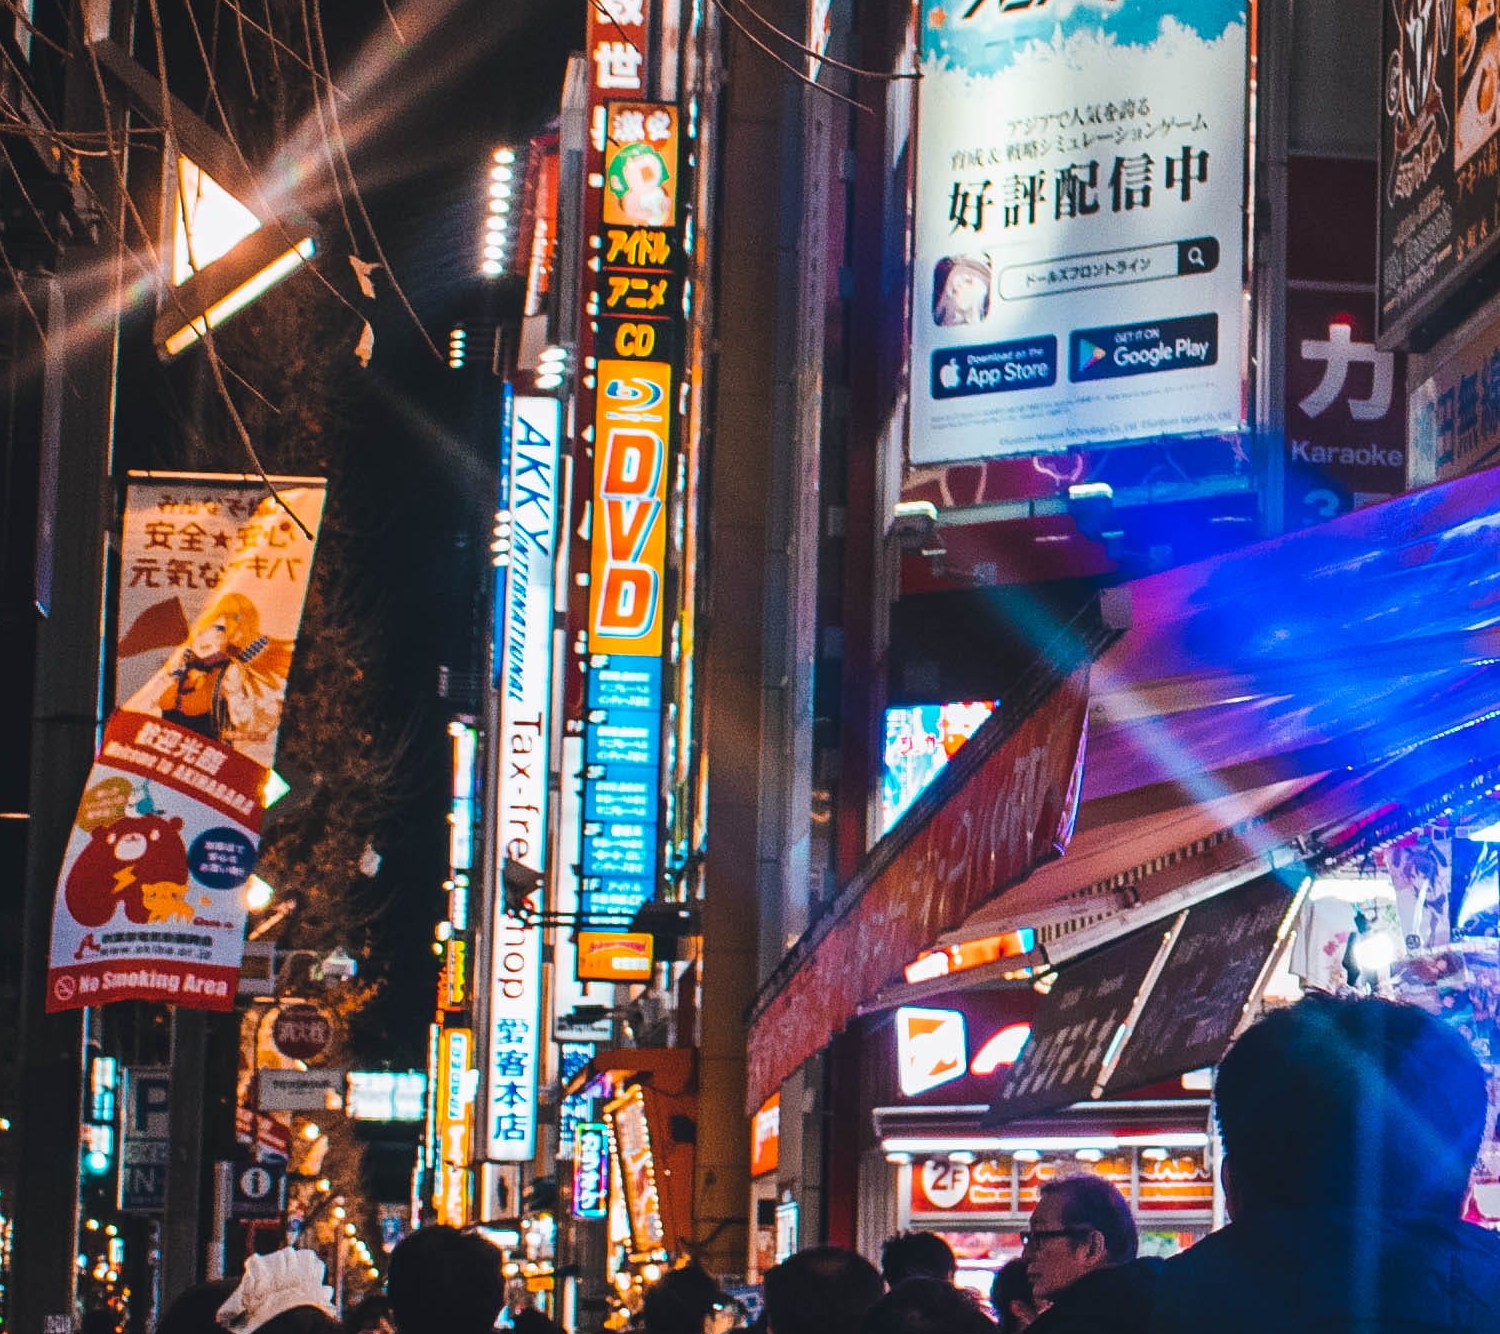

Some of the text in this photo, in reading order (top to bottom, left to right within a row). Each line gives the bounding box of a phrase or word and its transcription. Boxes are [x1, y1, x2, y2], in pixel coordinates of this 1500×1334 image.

[948, 146, 1209, 234] 好評配信中
[607, 230, 670, 266] アイドル
[607, 277, 667, 309] アニメ
[615, 322, 655, 357] CD
[1113, 338, 1209, 367] Google Play
[966, 361, 1049, 387] App Store
[1291, 438, 1404, 467] Karaoke
[515, 416, 551, 557] AKKY
[596, 428, 663, 639] DVD
[508, 529, 529, 701] INTERNATIONAL
[508, 712, 542, 864] Tax-free
[79, 969, 229, 997] No Smoking Area
